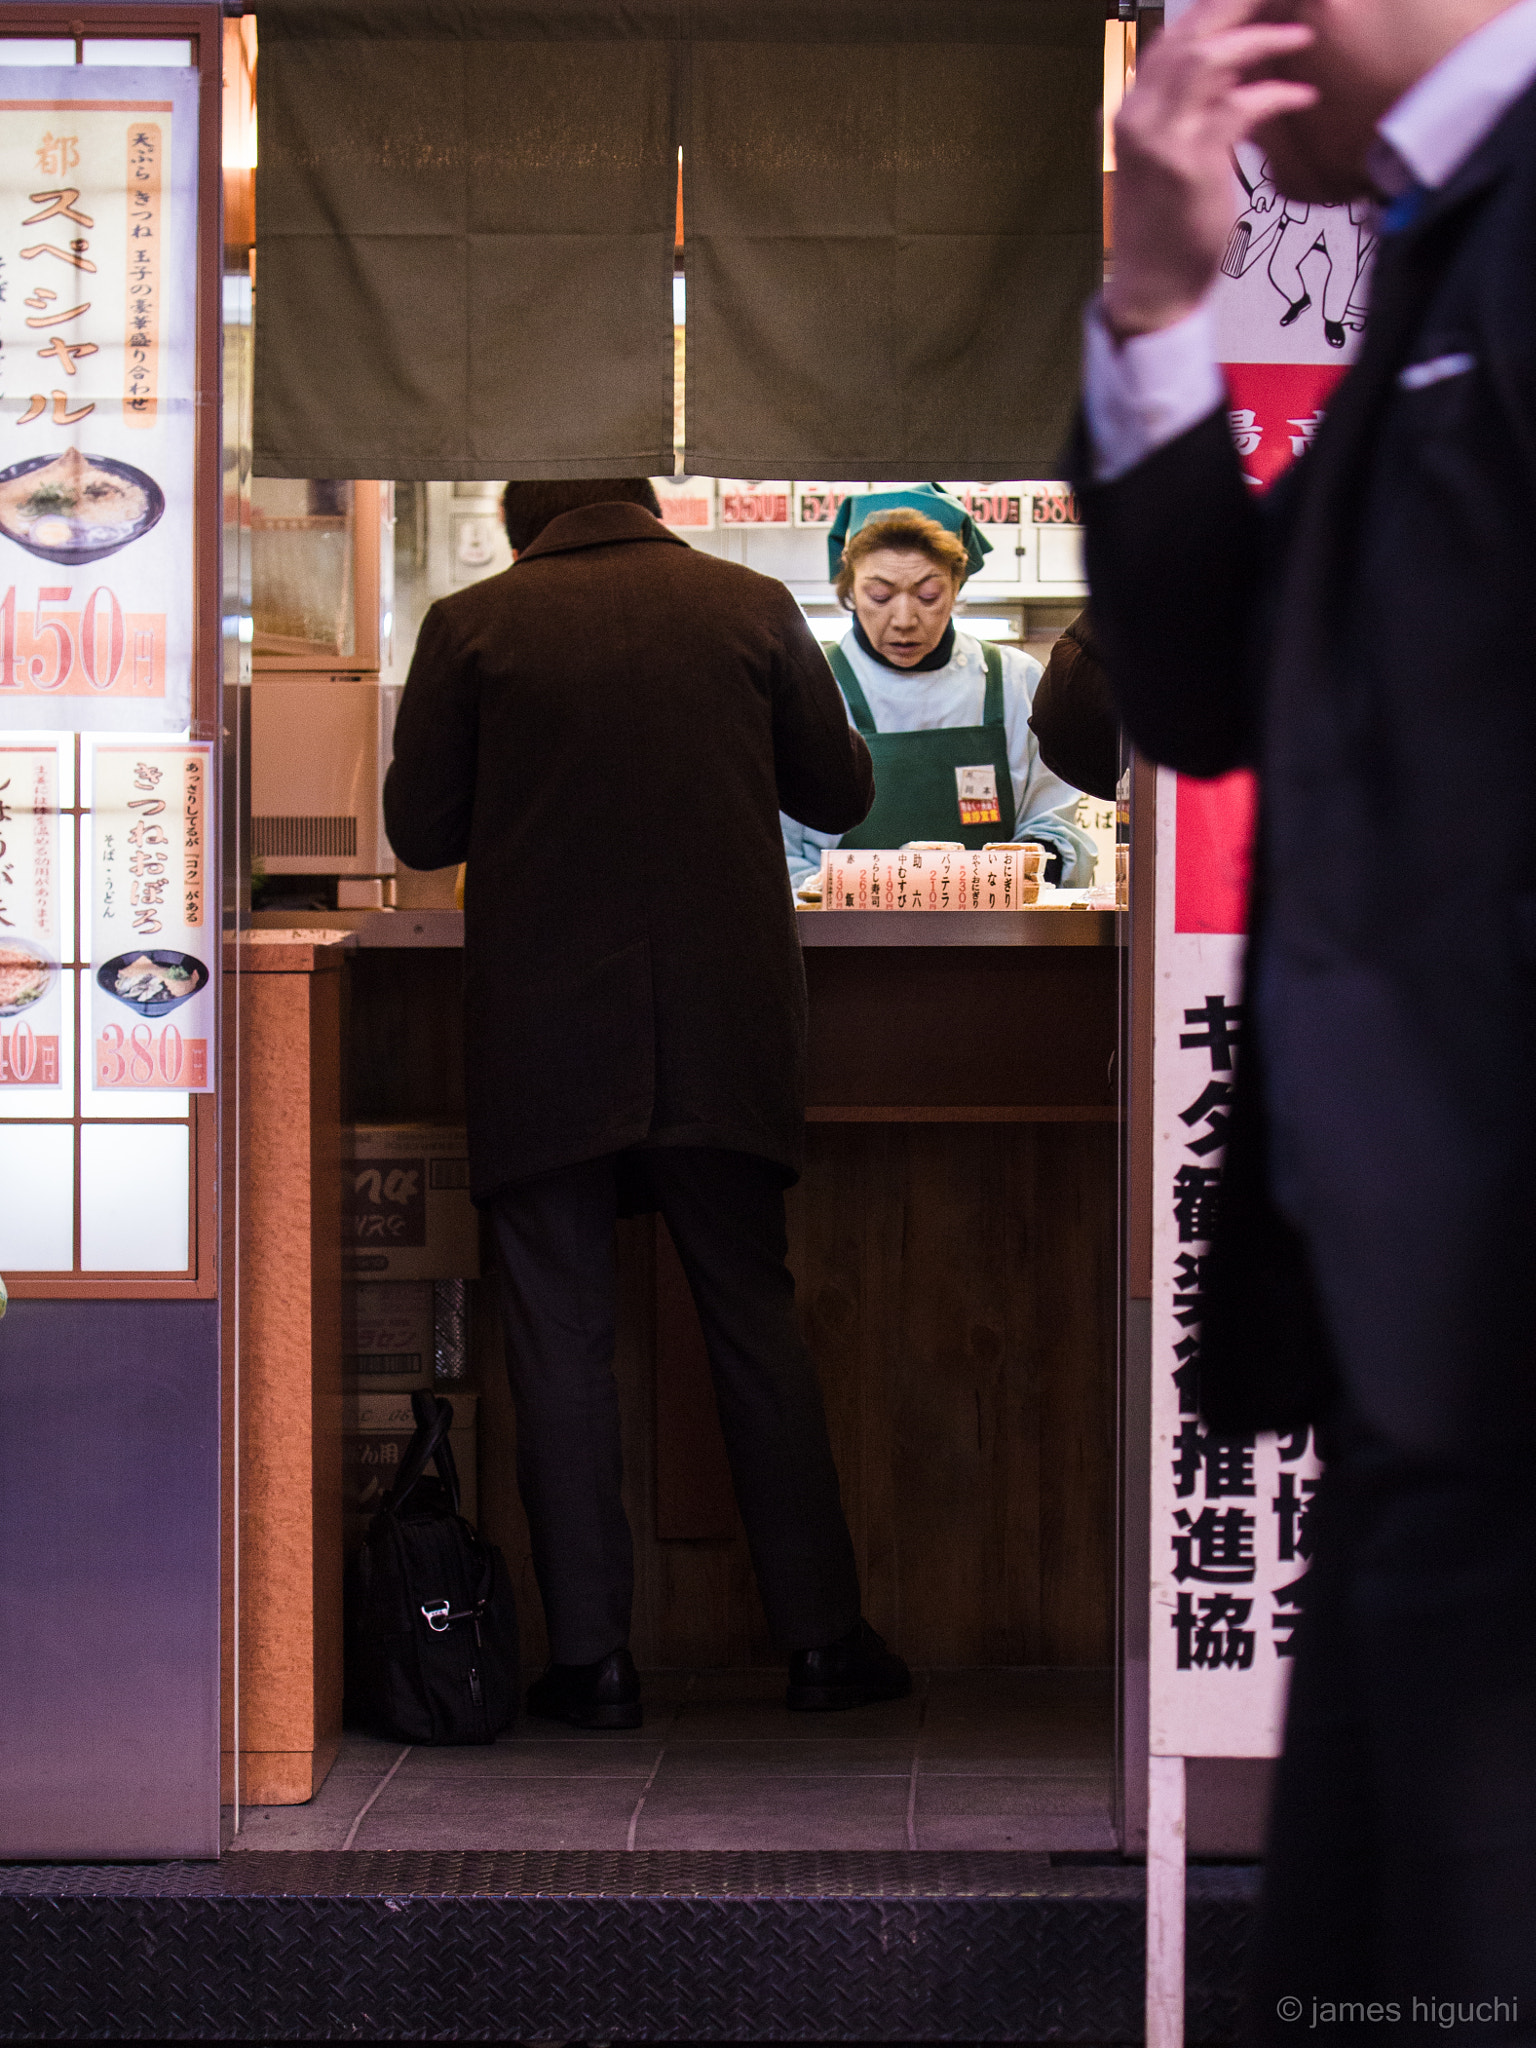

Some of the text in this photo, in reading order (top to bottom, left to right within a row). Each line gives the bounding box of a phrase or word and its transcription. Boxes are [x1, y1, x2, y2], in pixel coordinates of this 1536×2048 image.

[127, 762, 170, 935] きつねおぼろ
[871, 853, 880, 908] ちらし寿司
[897, 853, 907, 908] 中むすび
[987, 854, 998, 908] いなり
[1003, 853, 1013, 908] おにぎり
